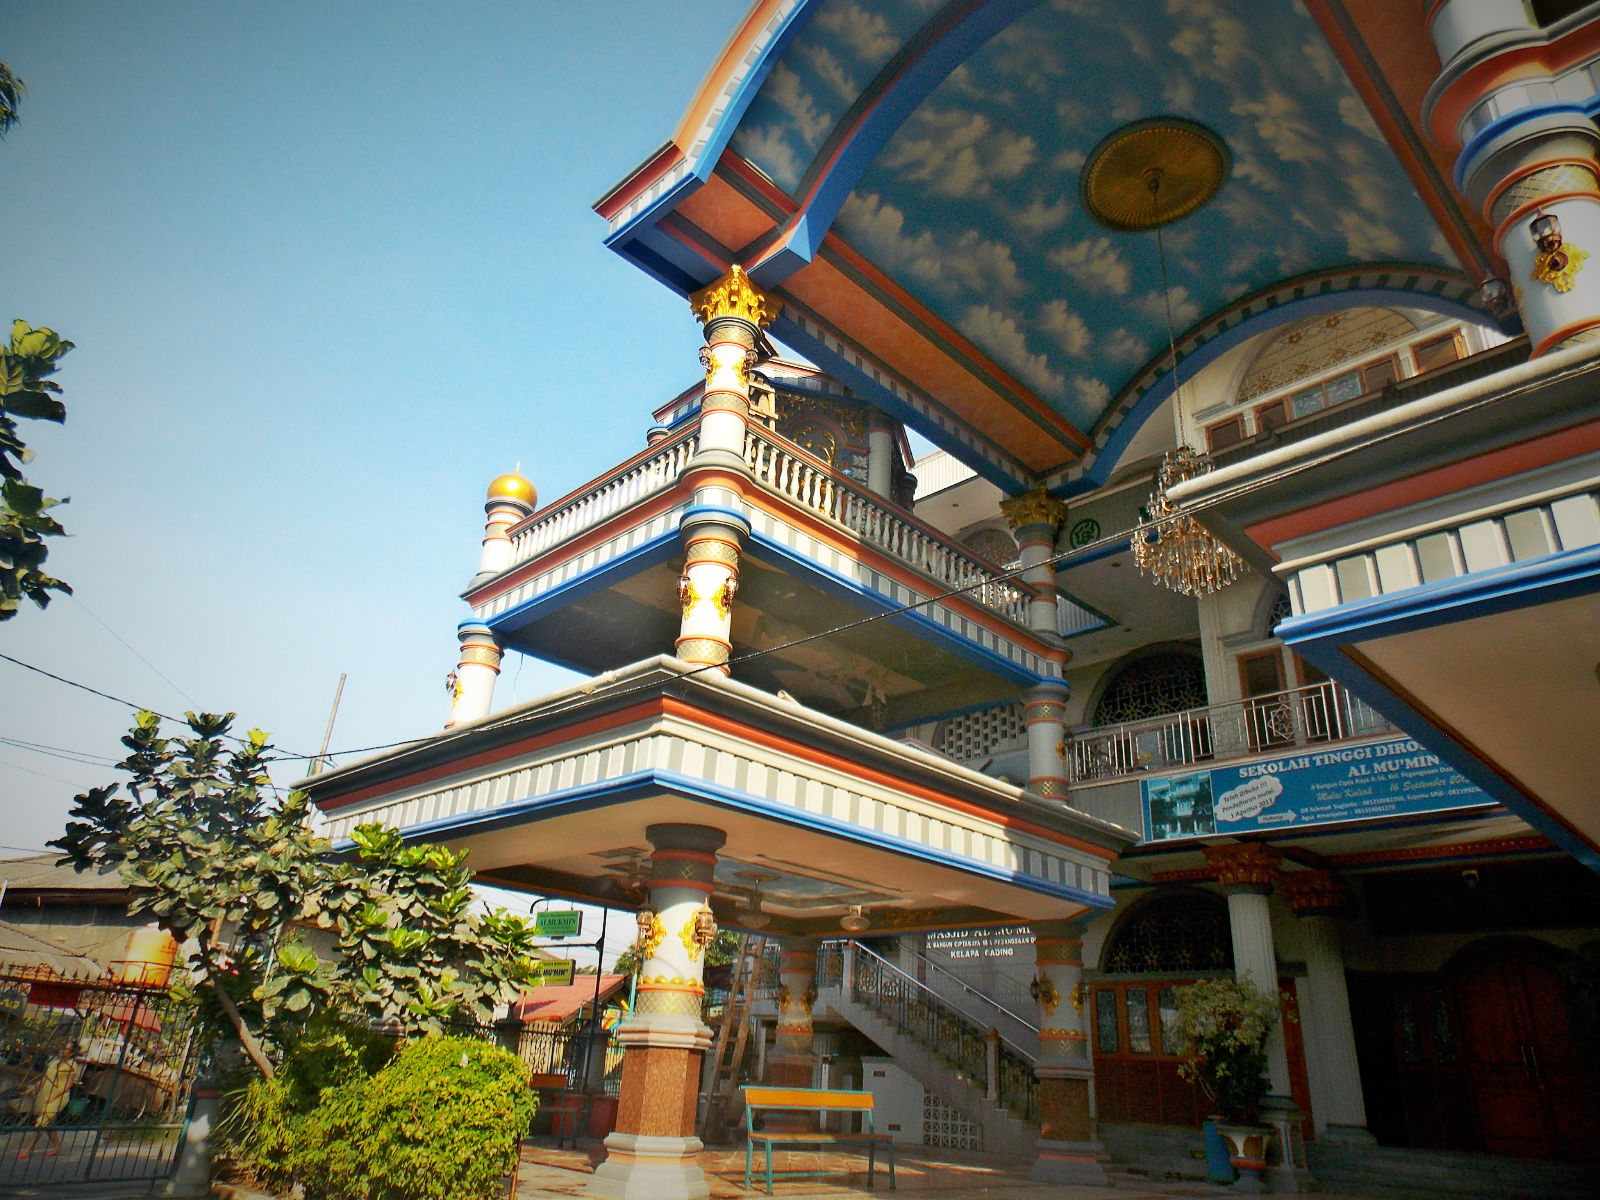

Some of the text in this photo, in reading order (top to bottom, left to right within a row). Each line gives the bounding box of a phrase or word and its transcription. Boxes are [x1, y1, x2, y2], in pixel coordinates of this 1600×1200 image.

[1239, 759, 1310, 778] SEKOLAH
[1313, 749, 1373, 766] TINGGI
[1348, 754, 1440, 777] AL MU'MIN
[951, 949, 980, 958] KELAPA
